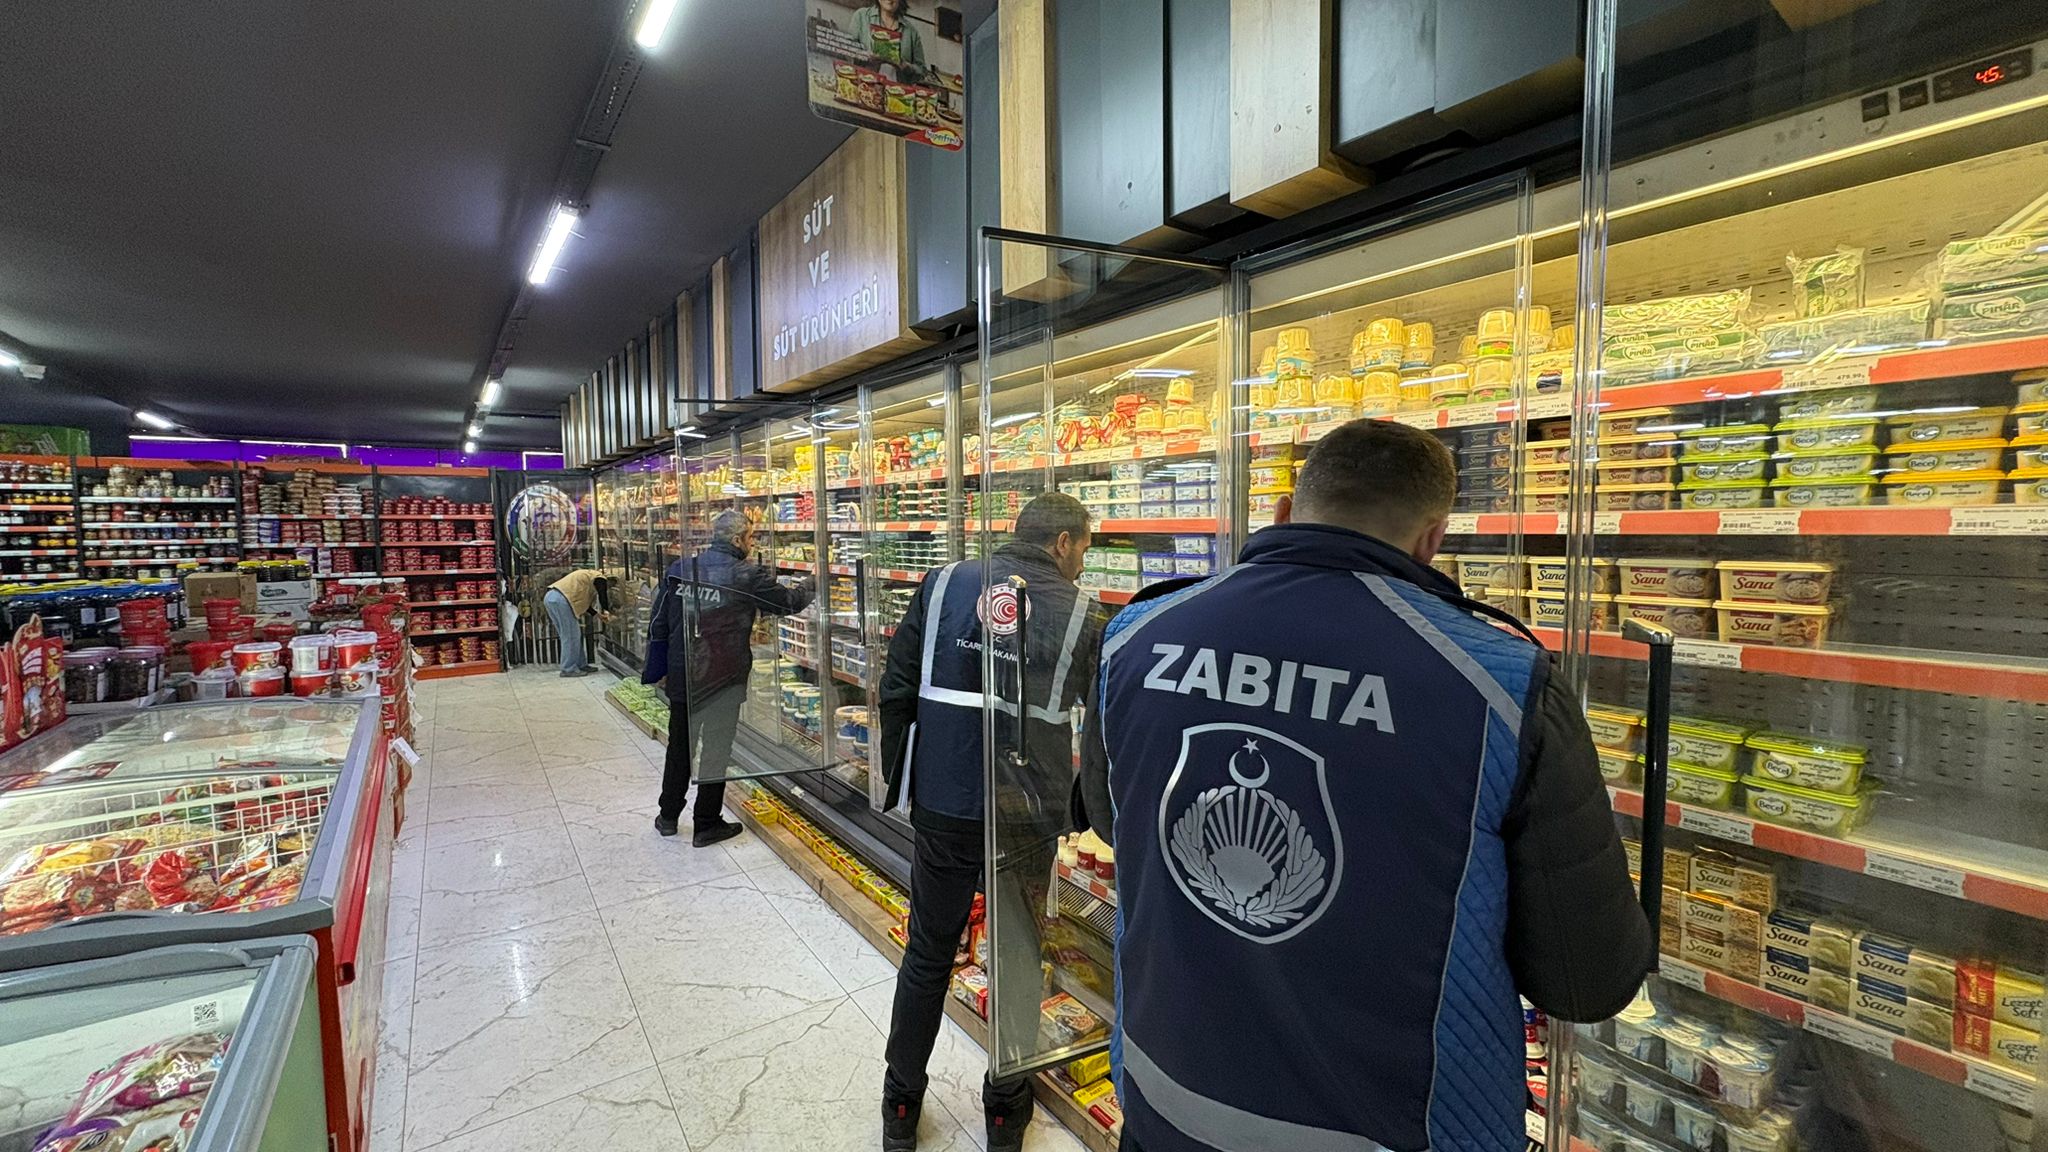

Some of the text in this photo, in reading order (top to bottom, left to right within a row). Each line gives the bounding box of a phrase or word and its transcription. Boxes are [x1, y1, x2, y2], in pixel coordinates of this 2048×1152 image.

[803, 195, 833, 244] SÜT
[808, 250, 830, 288] VE
[1982, 301, 2021, 314] PINAR
[774, 274, 878, 361] SÜT ÜRÜNLERİ
[1464, 567, 1489, 577] Sana
[1537, 570, 1566, 580] Sana
[1631, 573, 1666, 585] Sana
[1733, 577, 1776, 590] Sana
[1537, 604, 1565, 615] Sana
[1731, 618, 1773, 632] Sana
[1143, 643, 1396, 734] ZABITA
[1766, 762, 1790, 776] Becel
[1758, 800, 1785, 812] Becel
[1695, 869, 1735, 889] Sana
[1686, 903, 1724, 923] Sana
[1766, 926, 1810, 948] Sana
[1686, 939, 1723, 959] Sana
[1857, 953, 1908, 977] Sana
[1766, 964, 1809, 986] Sana
[1856, 995, 1907, 1018] Sana
[2002, 997, 2043, 1008] Lezzet
[1997, 1040, 2039, 1052] Lezzet
